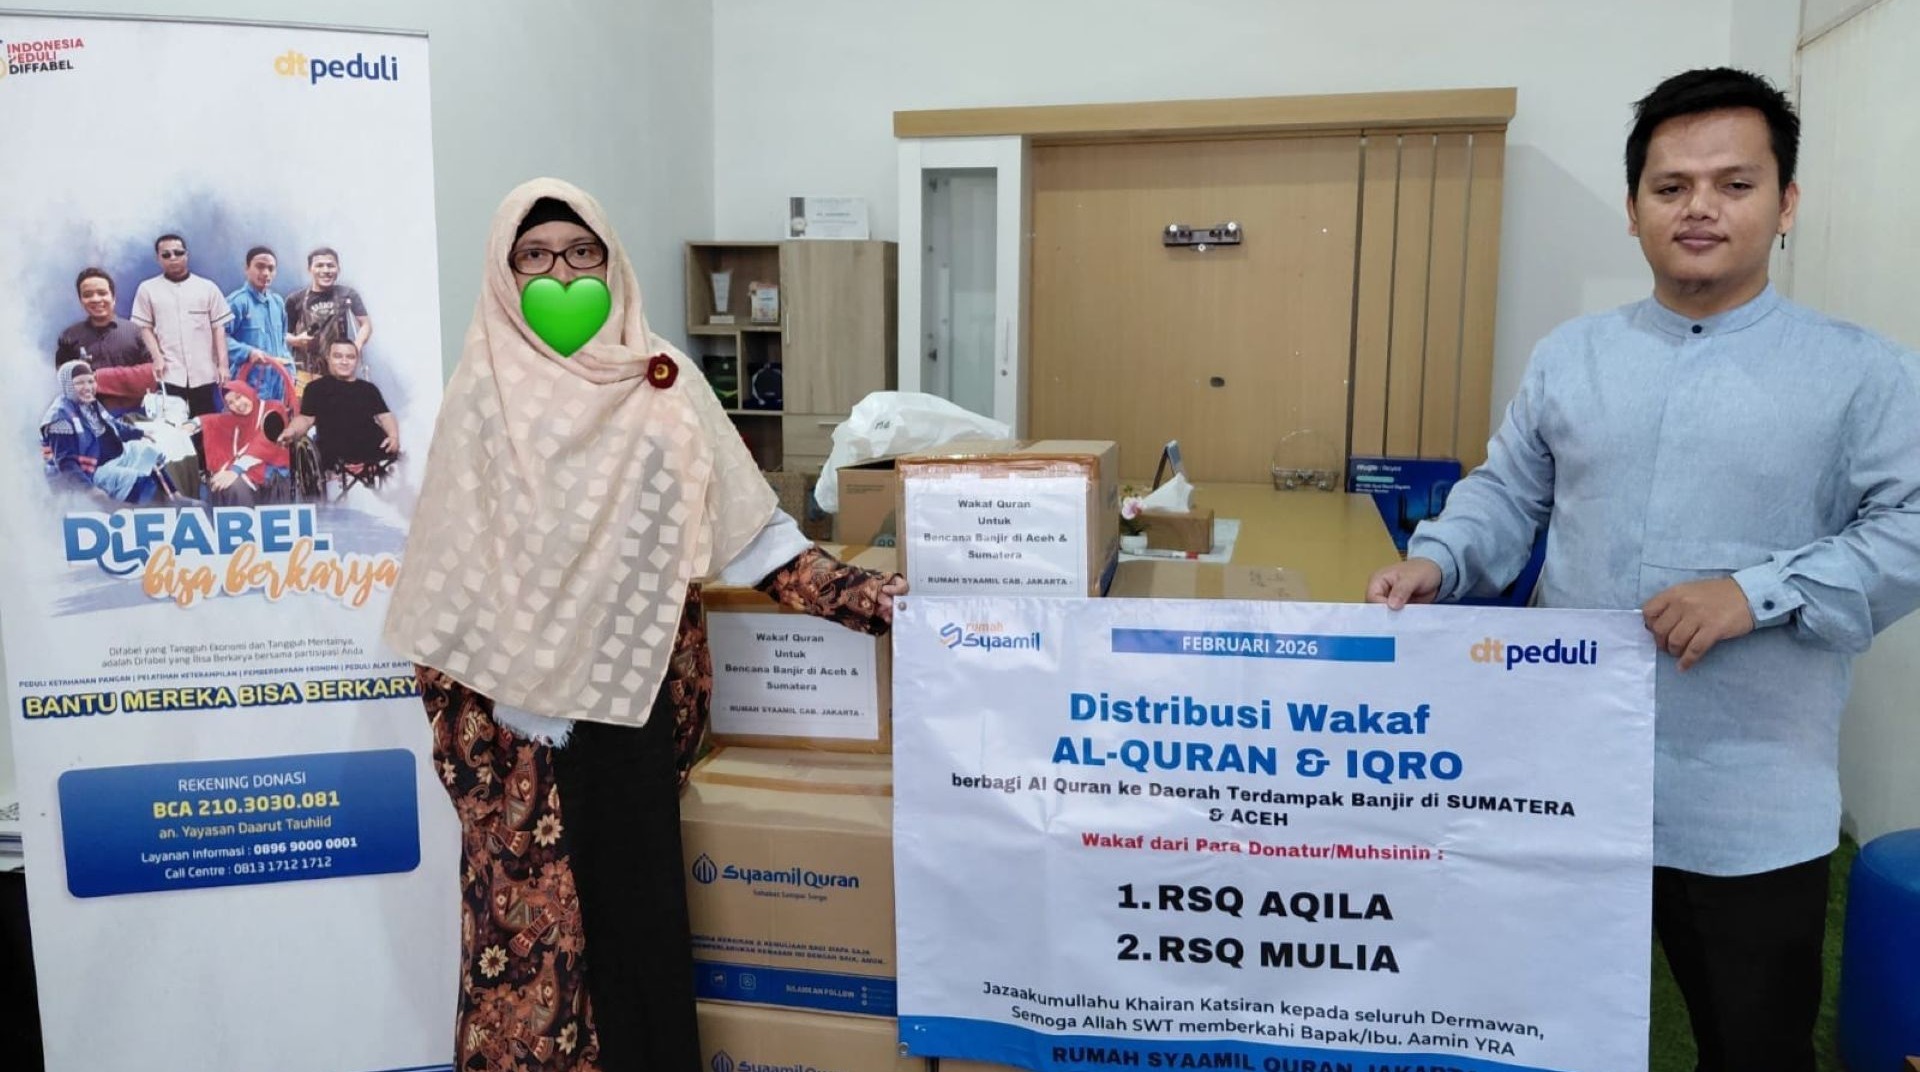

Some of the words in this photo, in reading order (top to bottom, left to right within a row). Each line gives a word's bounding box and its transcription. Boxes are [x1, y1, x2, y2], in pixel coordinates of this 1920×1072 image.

[7, 38, 84, 53] INDONESIA
[9, 60, 74, 75] DIFFABEL
[274, 51, 398, 84] dtpeduli
[958, 500, 992, 508] Wakaf
[997, 500, 1031, 509] Quran
[978, 517, 1011, 525] Untuk
[924, 533, 971, 542] Bencana
[975, 533, 1007, 544] Banjir
[1011, 533, 1022, 542] di
[1026, 533, 1055, 542] Aceh
[1058, 534, 1068, 542] &
[968, 550, 1022, 559] Sumatera
[142, 544, 216, 606] bisa
[226, 537, 400, 606] berkarya
[966, 621, 1004, 632] rumah
[109, 646, 142, 656] Difabel
[145, 646, 166, 656] yang
[249, 640, 265, 650] dan
[268, 639, 305, 650] Tangguh
[756, 632, 788, 641] Wakaf
[792, 633, 824, 643] Quran
[962, 632, 1040, 652] Syaamil
[1182, 636, 1269, 653] FEBRUARI
[1275, 639, 1318, 655] 2026
[102, 658, 132, 668] adalah
[134, 656, 166, 667] Difabel
[169, 656, 190, 666] yang
[213, 653, 252, 664] Berkarya
[254, 650, 292, 660] bersama
[294, 649, 339, 660] partisipasi
[342, 647, 363, 656] Anda
[775, 649, 806, 658] Untuk
[1470, 637, 1598, 670] dtpeduli
[392, 660, 414, 669] BANT
[725, 663, 770, 674] Bencana
[773, 665, 803, 676] Banjir
[806, 666, 817, 675] di
[820, 667, 847, 676] Aceh
[850, 667, 859, 676] &
[766, 681, 817, 691] Sumatera
[23, 692, 118, 718] BANTU
[123, 686, 237, 713] MEREKA
[239, 682, 302, 707] BISA
[304, 676, 421, 703] BERKARY
[821, 708, 859, 716] JAKARTA
[1070, 693, 1271, 729] Distribusi
[1287, 702, 1430, 735] Wakaf
[1052, 736, 1278, 776] AL-QURAN
[1296, 747, 1330, 777] &
[1346, 750, 1463, 785] IQRO
[178, 776, 249, 792] REKENING
[253, 772, 306, 788] DONASI
[153, 802, 193, 819] BCA
[198, 790, 340, 816] 210.3030.081
[951, 773, 1021, 793] berbagi
[1028, 776, 1047, 791] Al
[1053, 777, 1111, 795] Quran
[1118, 780, 1142, 796] ke
[1149, 783, 1220, 800] Daerah
[1227, 786, 1344, 808] Terdampak
[1351, 792, 1414, 811] Banjir
[1421, 792, 1439, 808] di
[1447, 794, 1575, 817] SUMATERA
[159, 828, 178, 839] an.
[182, 824, 235, 840] Yayasan
[238, 821, 282, 834] Daarut
[286, 815, 331, 830] Tauhiid
[1209, 808, 1224, 822] &
[1231, 808, 1288, 826] ACEH
[141, 851, 189, 864] Layanan
[192, 847, 245, 860] Informasi
[254, 842, 286, 855] 0896
[290, 840, 322, 852] 9000
[326, 837, 357, 849] 0001
[1081, 832, 1144, 849] Wakaf
[1151, 835, 1189, 851] dari
[1196, 838, 1241, 853] Para
[1248, 840, 1430, 861] Donatur/Muhsinin
[165, 867, 185, 879] Call
[188, 865, 225, 877] Centre
[234, 863, 265, 875] 0813
[268, 859, 297, 871] 1712
[302, 856, 331, 869] 1712
[722, 865, 800, 887] Syaamil
[804, 871, 859, 888] Quran
[1259, 891, 1394, 923] AQILA
[1260, 942, 1400, 973] MULIA
[982, 981, 1120, 1010] Jazaakumullahu
[1125, 997, 1194, 1012] Khairan
[1200, 997, 1274, 1014] Katsiran
[1280, 1001, 1349, 1021] kepada
[1355, 1008, 1425, 1024] seluruh
[1431, 1011, 1544, 1041] Dermawan,
[1011, 1005, 1077, 1030] Semoga
[1082, 1015, 1127, 1031] Allah
[1132, 1018, 1174, 1033] SWT
[1179, 1018, 1294, 1038] memberkahi
[1301, 1024, 1402, 1046] Bapak/Ibu.
[1407, 1032, 1468, 1049] Aamin
[1475, 1037, 1516, 1057] YRA
[1052, 1046, 1139, 1066] RUMAH
[1147, 1052, 1255, 1071] SYAAMIL
[1263, 1056, 1353, 1072] QURAN
